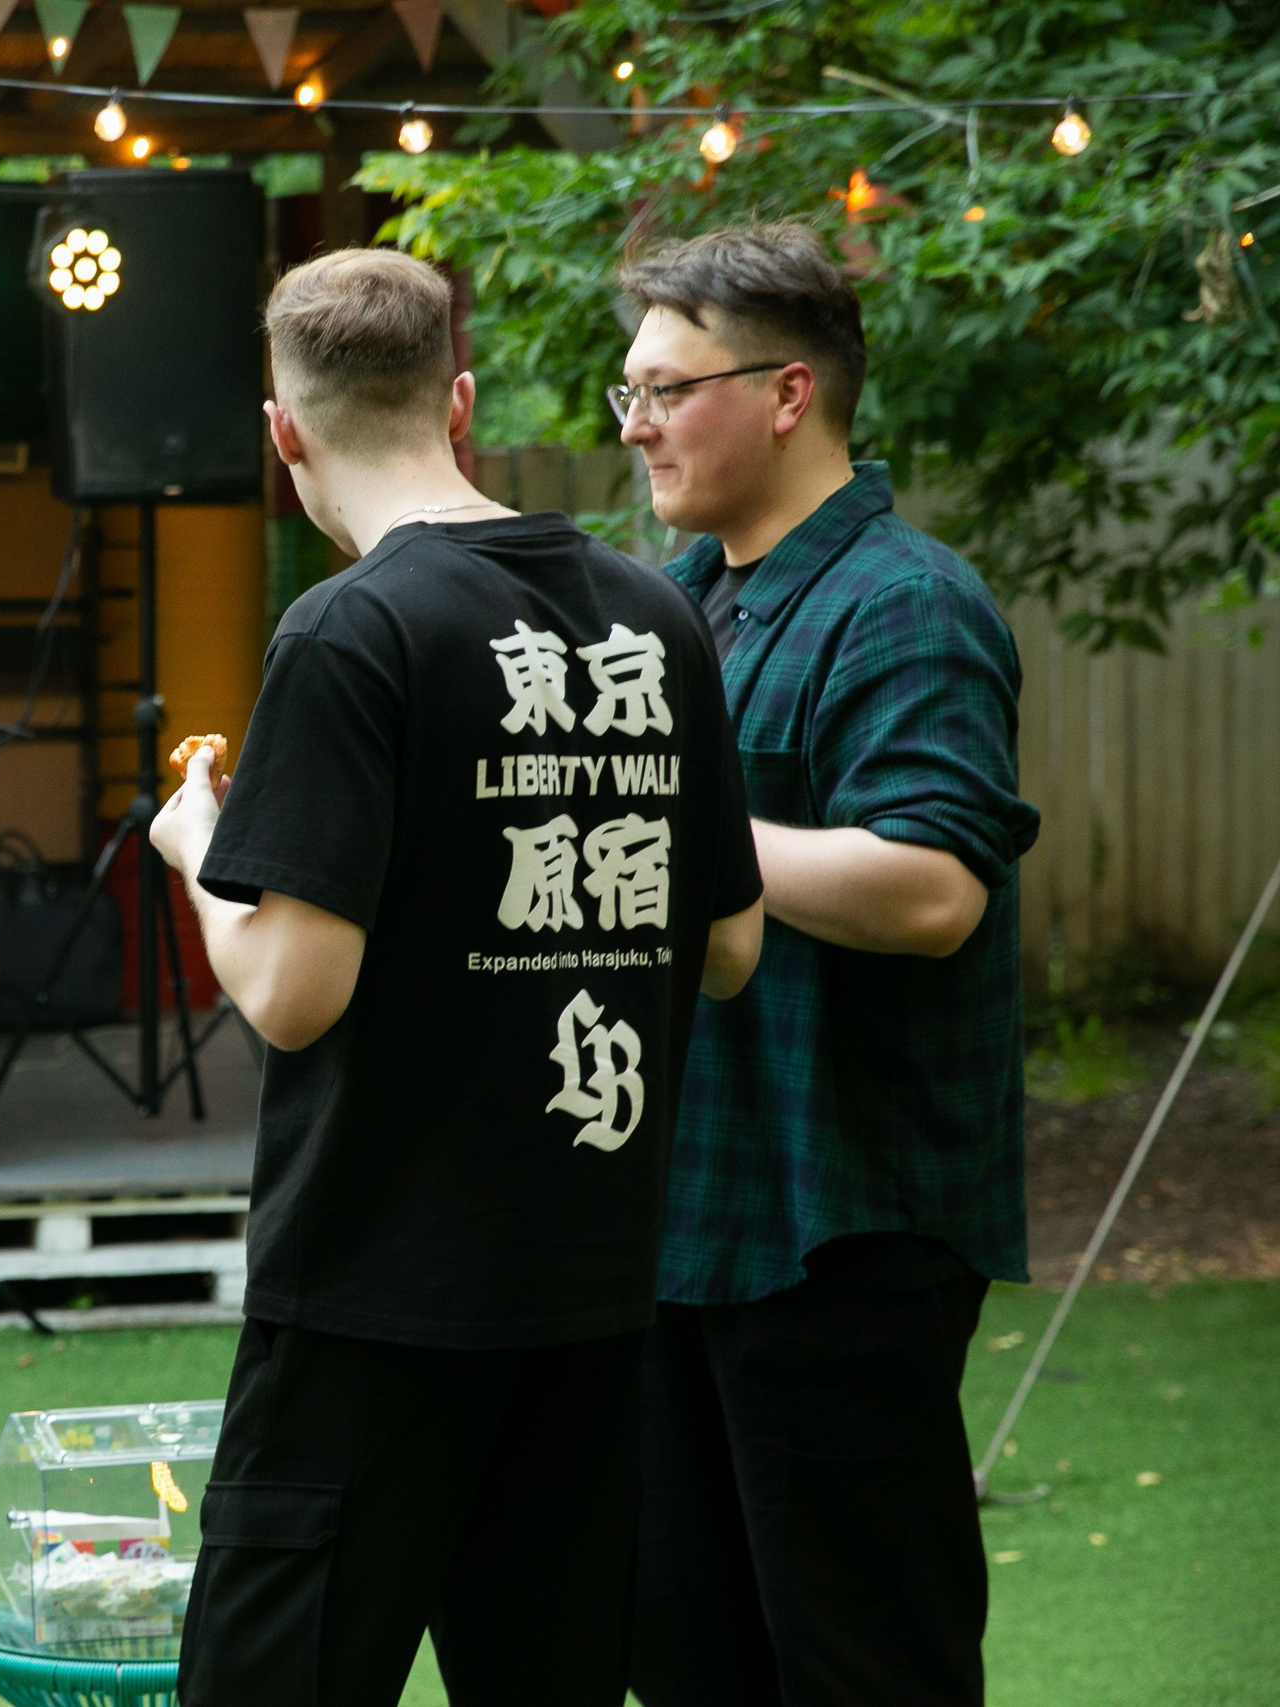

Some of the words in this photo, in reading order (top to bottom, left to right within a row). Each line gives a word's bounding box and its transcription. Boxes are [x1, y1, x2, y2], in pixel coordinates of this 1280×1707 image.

[488, 618, 674, 738] 東京
[476, 754, 607, 800] LIBERTY
[610, 754, 681, 796] WALK
[497, 812, 673, 934] 原宿
[468, 952, 557, 975] Expanded
[558, 951, 579, 969] into
[581, 948, 653, 971] Harajuku,
